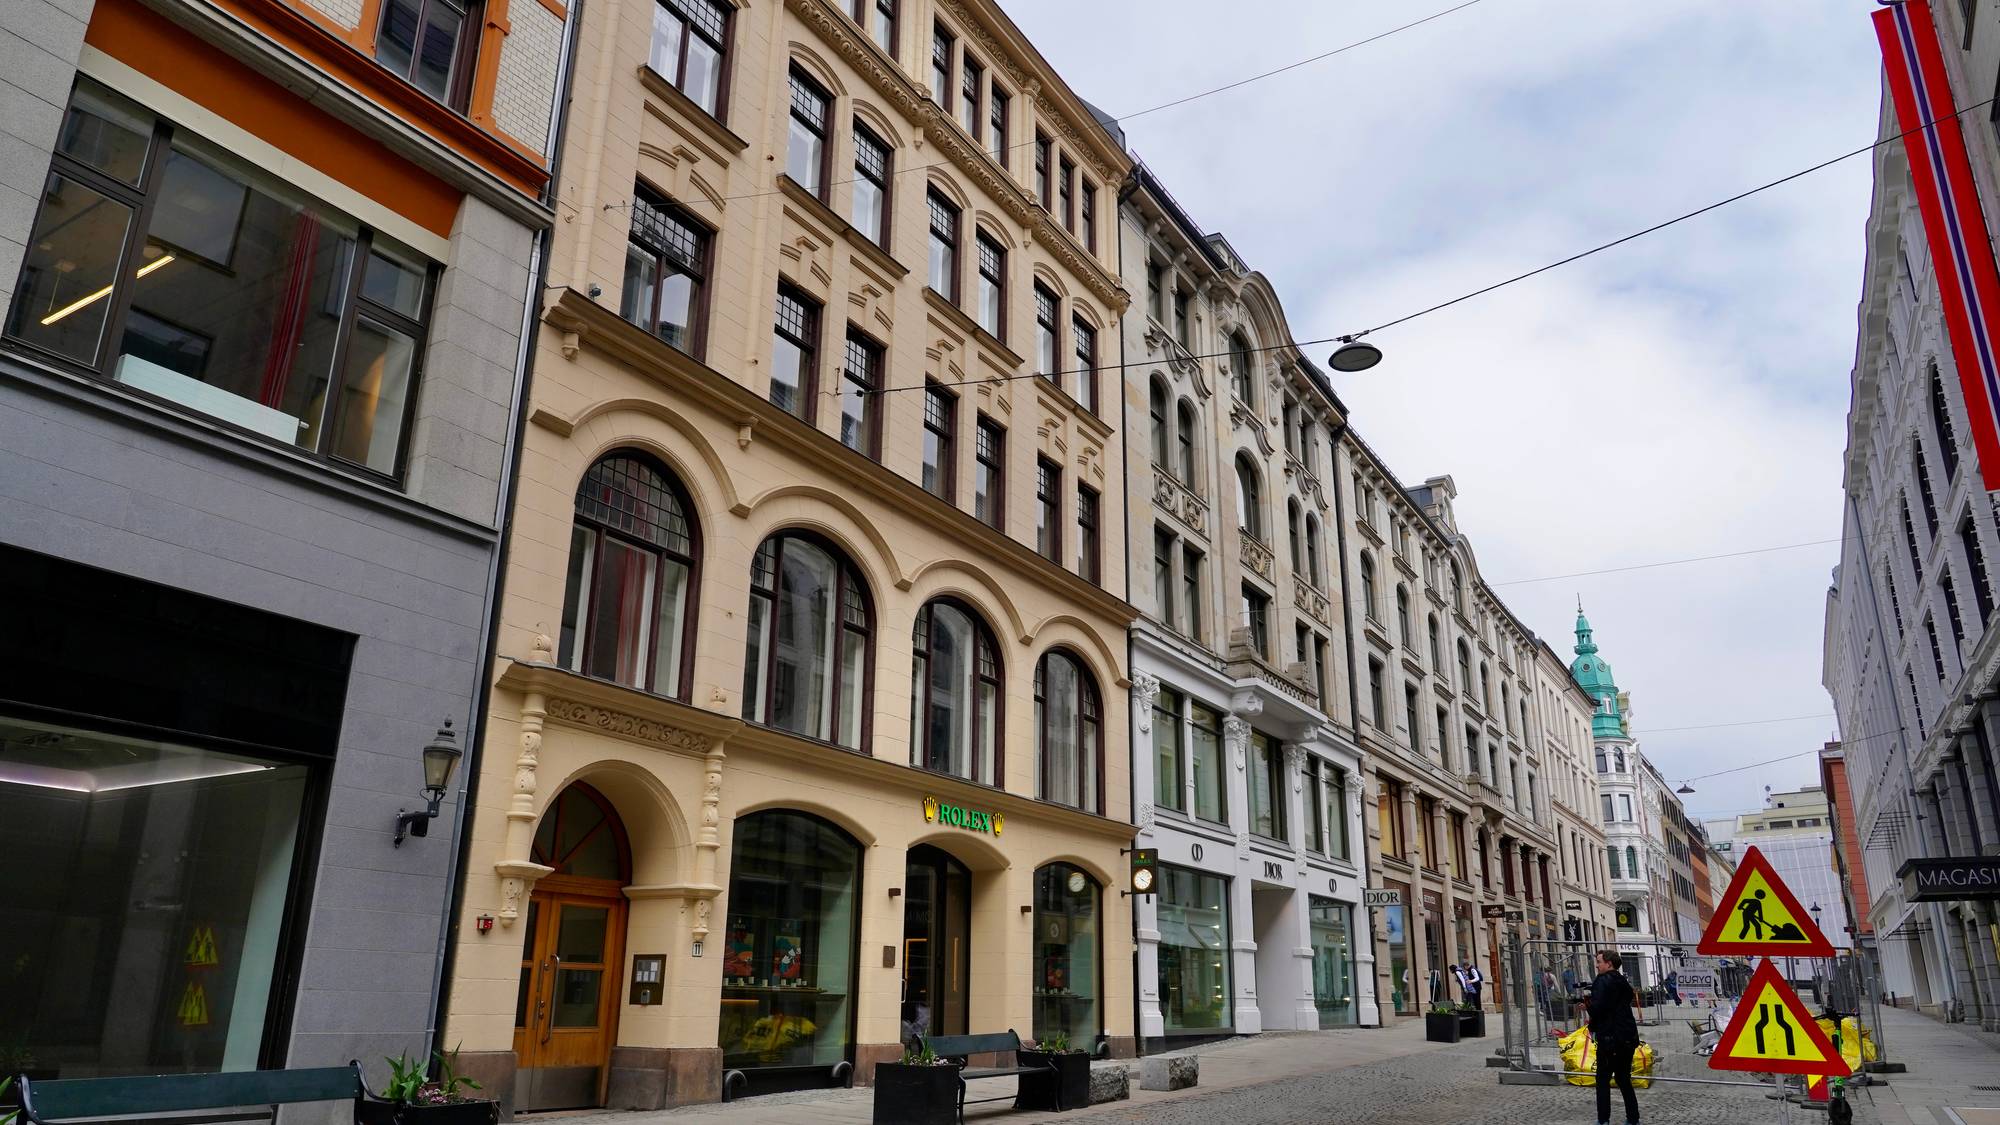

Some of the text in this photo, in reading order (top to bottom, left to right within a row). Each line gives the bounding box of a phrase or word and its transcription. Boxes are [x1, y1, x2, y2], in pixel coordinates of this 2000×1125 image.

[939, 803, 991, 832] ROLEX
[1264, 861, 1283, 880] DIOR
[1918, 868, 2000, 886] MAGASI
[1367, 892, 1400, 904] DIOR
[694, 943, 701, 955] 11
